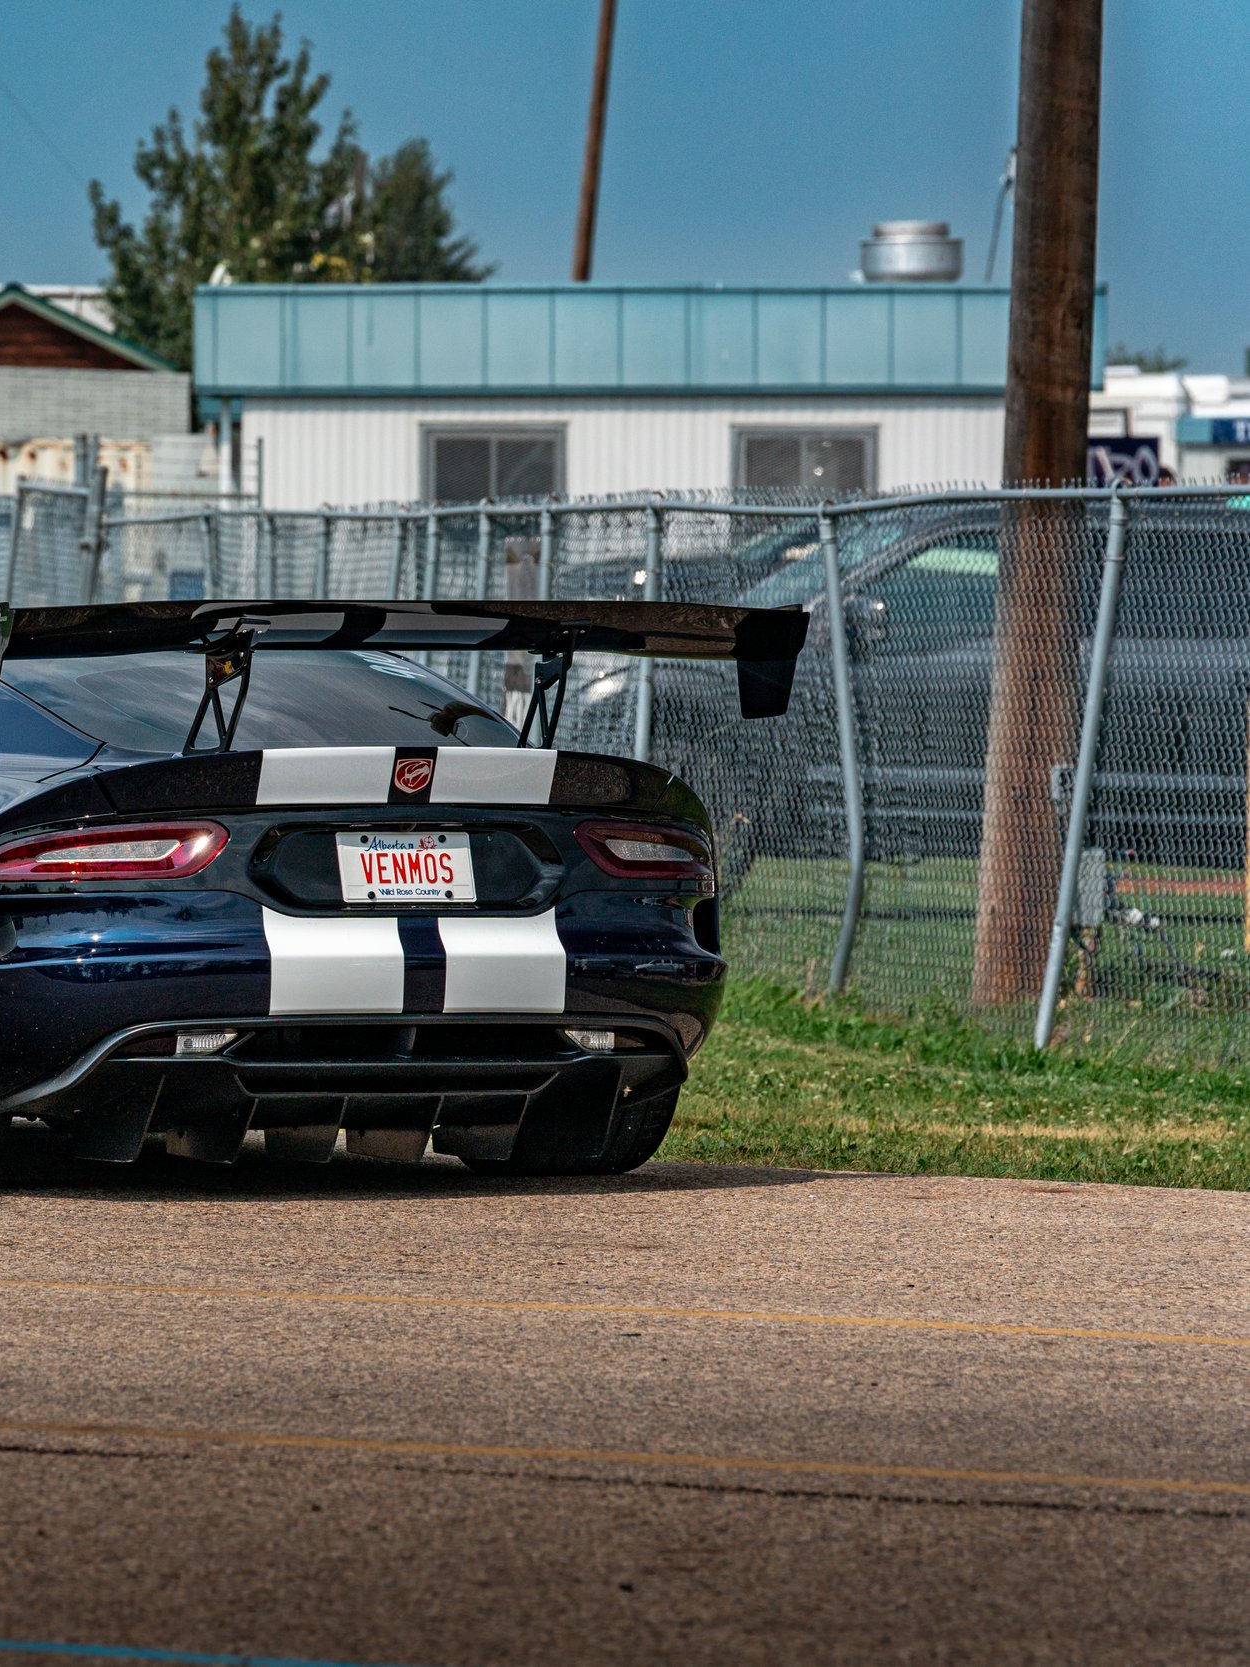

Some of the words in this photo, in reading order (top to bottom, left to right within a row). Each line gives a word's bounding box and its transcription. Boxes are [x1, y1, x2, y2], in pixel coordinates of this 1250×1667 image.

[365, 836, 407, 851] Alberta
[360, 852, 454, 884] VENMOS
[379, 888, 395, 896] Wild
[396, 888, 414, 896] Rose
[415, 888, 441, 897] Country
